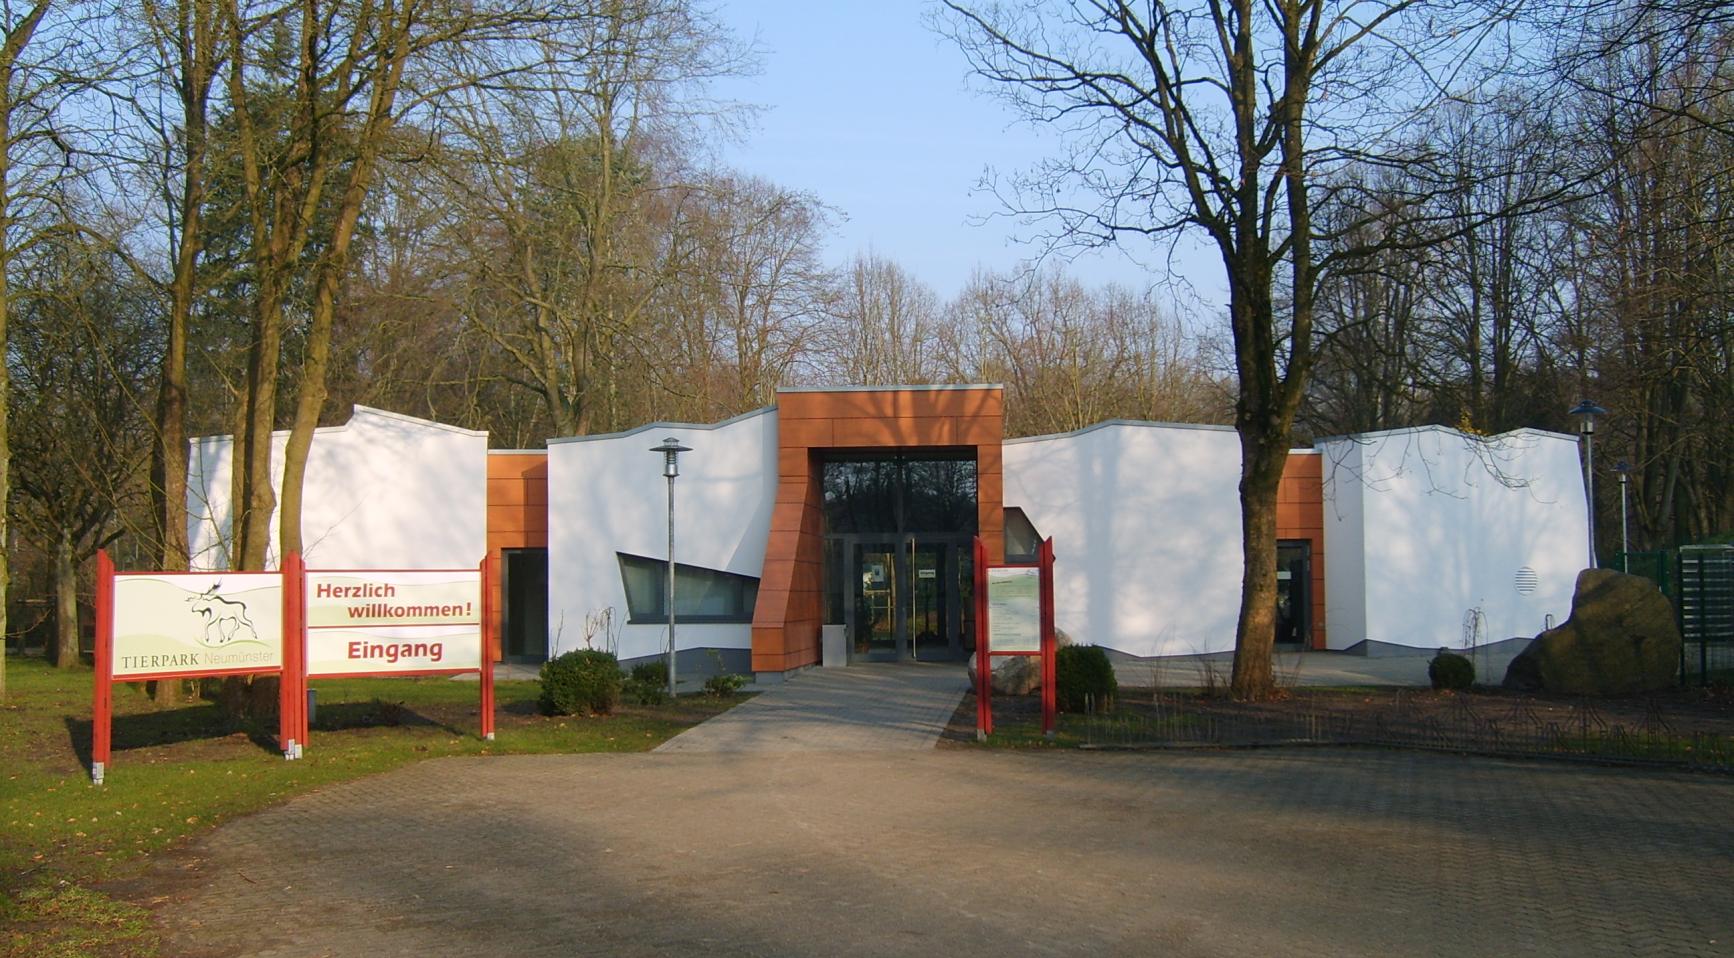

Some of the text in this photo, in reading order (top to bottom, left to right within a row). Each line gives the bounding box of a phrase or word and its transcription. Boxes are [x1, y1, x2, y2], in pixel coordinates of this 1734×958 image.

[316, 583, 395, 598] Herzlich
[347, 602, 472, 619] willkommen!
[122, 650, 274, 669] TIERPARK Neumünster
[347, 640, 443, 663] Eingang
